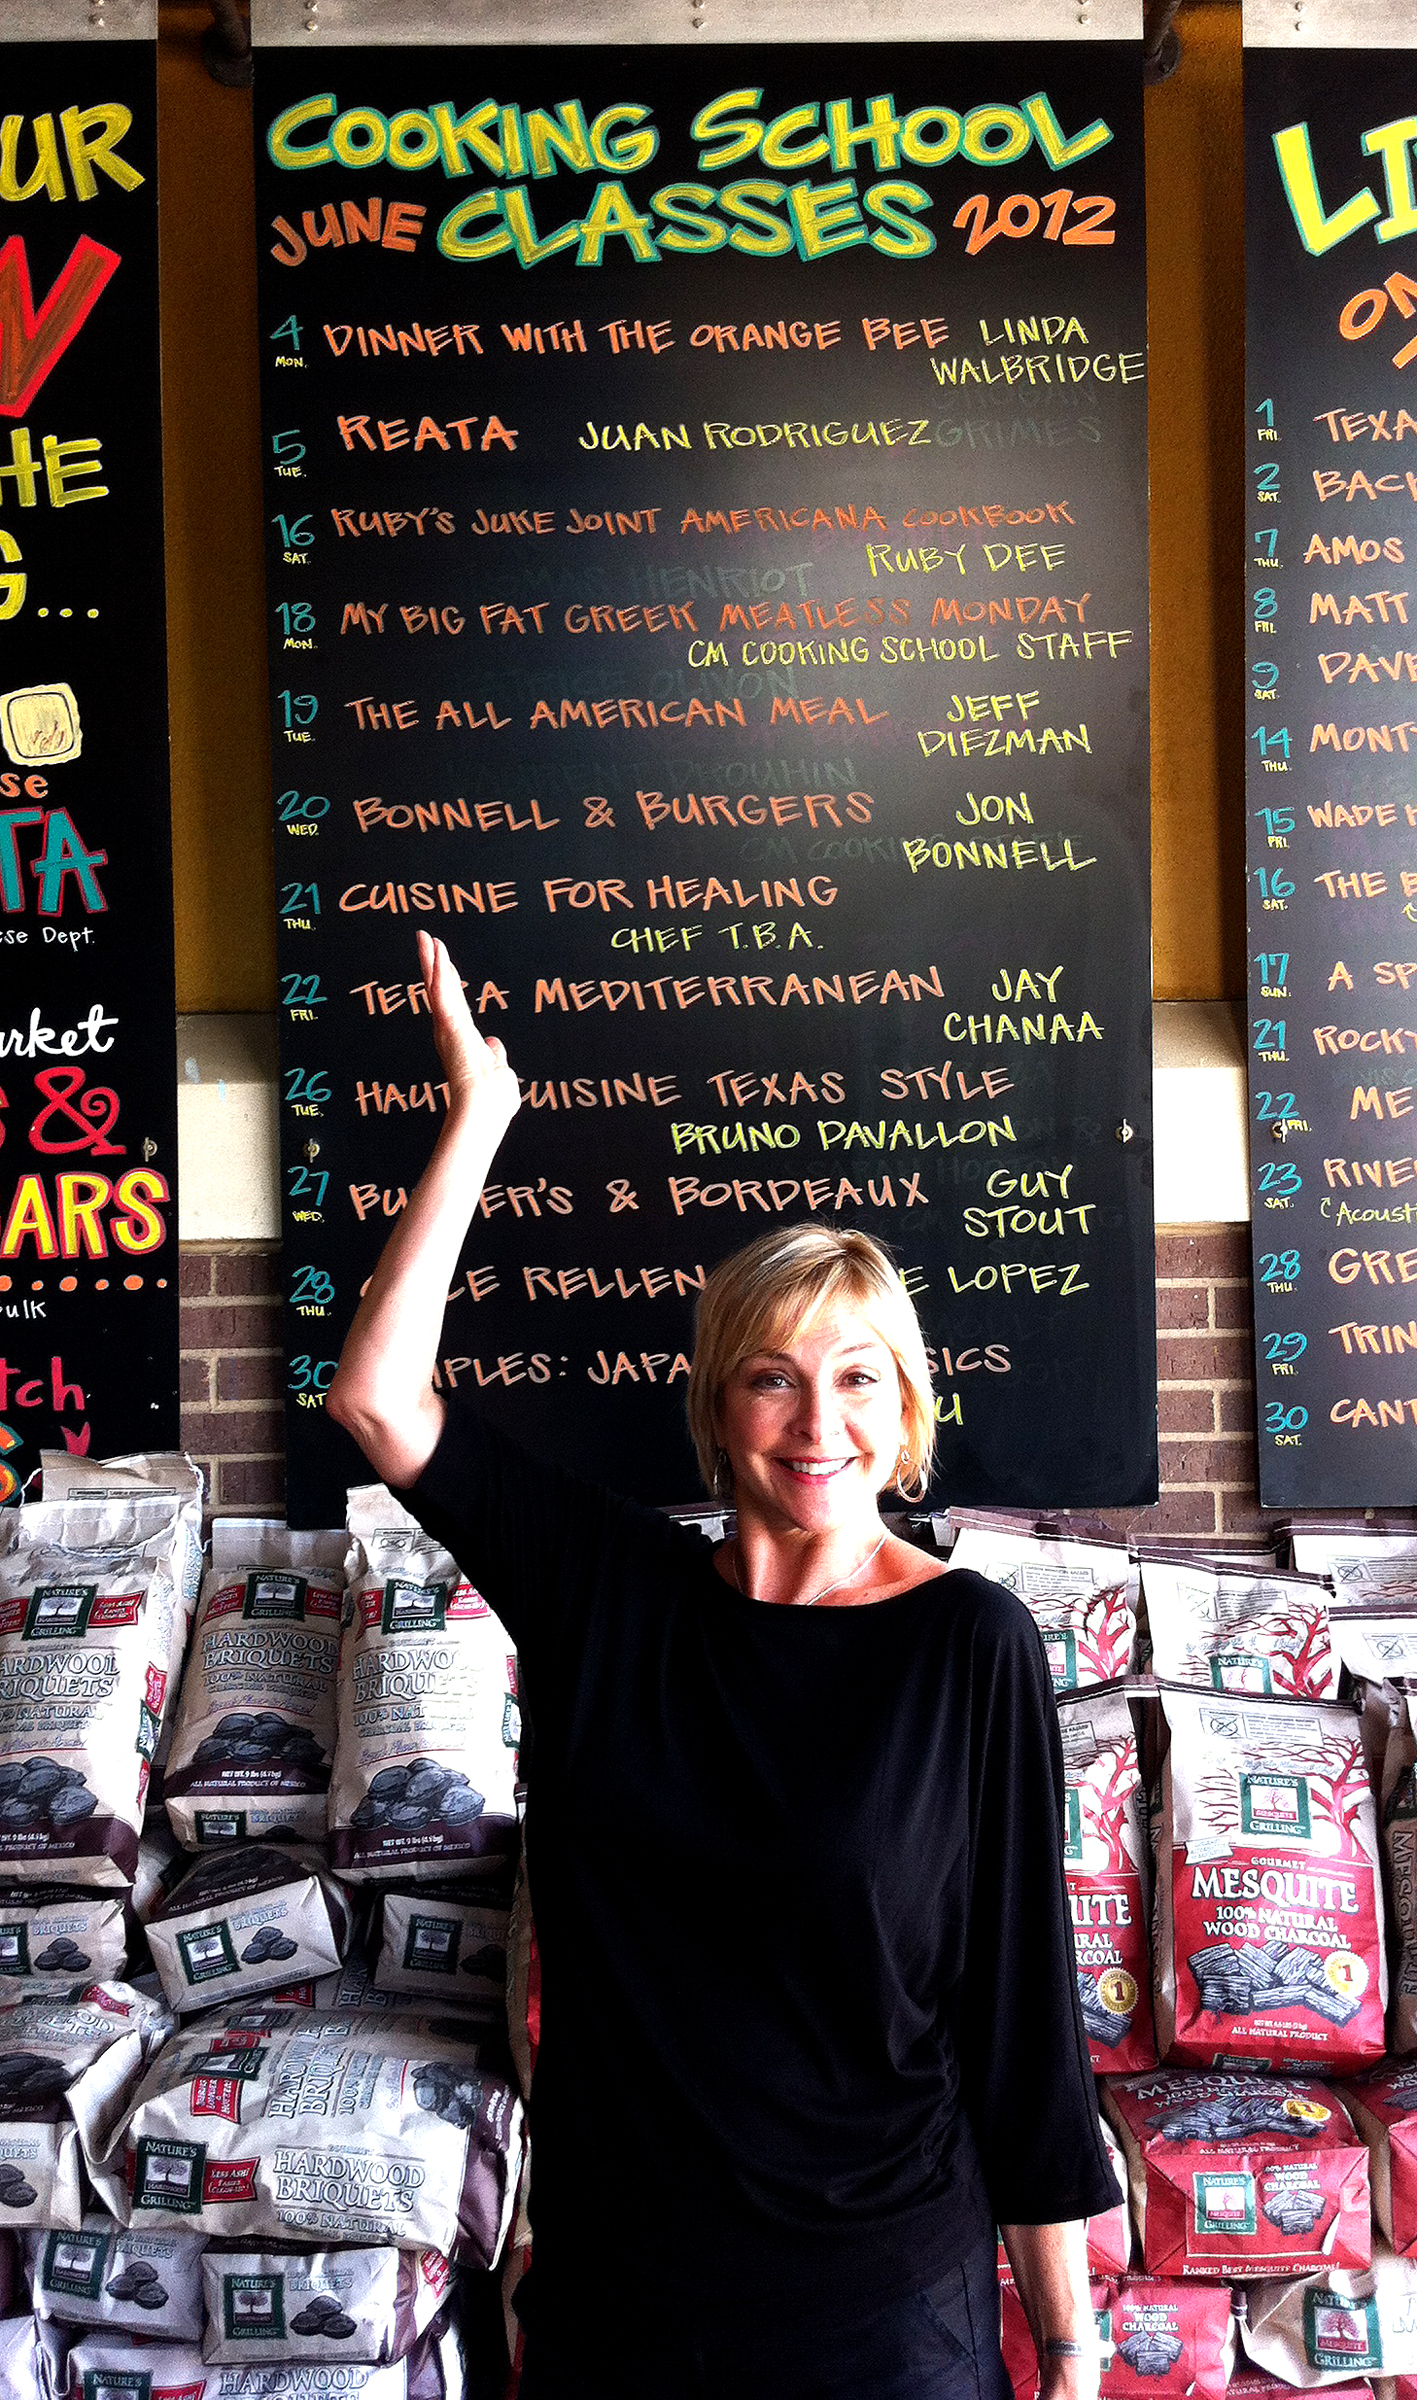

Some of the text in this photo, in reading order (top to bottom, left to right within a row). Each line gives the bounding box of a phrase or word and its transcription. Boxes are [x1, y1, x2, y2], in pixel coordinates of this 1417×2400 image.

[268, 87, 1114, 178] COOKING SCHOOL
[270, 179, 1117, 270] JUNE CLASSES 2012
[270, 315, 1090, 356] 4 DINNER WITH THE ORANGE BEE LINDA
[274, 355, 308, 368] MON.
[929, 351, 1146, 386] WALBRIDGE
[1254, 398, 1275, 428] 1
[271, 414, 932, 465] 5 REATA JUAN RODRIGUEZ
[273, 465, 307, 479] TUE.
[1253, 462, 1282, 491] 2
[271, 499, 1077, 548] 16 RUBY'S JUKE JOINT AMERICANA COOKBOOK
[282, 552, 312, 565] SAT.
[866, 541, 1068, 578] RUBY DEE
[1253, 528, 1406, 566] 7 AMOS
[274, 591, 1093, 636] 18 MY BIG FAT GREEK MEATLESS MONDAY
[1252, 586, 1410, 626] 8 MATT
[282, 636, 319, 650] MON.
[687, 629, 1135, 669] CM COOKING SCHOOL STAFF
[1251, 660, 1280, 690] 9
[276, 689, 1041, 732] 19 THE ALL AMERICAN MEAL JEFF
[282, 729, 316, 743] TUE.
[916, 723, 1094, 760] DIEZMAN
[1250, 725, 1293, 759] 14
[275, 789, 1035, 834] 20 BONNELL & BURGERS JON
[286, 822, 320, 836] WED.
[1253, 799, 1398, 836] 15 WADE
[901, 836, 1098, 874] BONNELL
[278, 874, 840, 916] 21 CUISINE FOR HEALING
[1253, 866, 1388, 900] 16 THE
[42, 925, 97, 953] Dept.
[282, 917, 317, 931] THU.
[610, 920, 826, 955] CHEF T.B.A.
[280, 964, 1066, 1015] 22 MEDITERRANEAN JAY
[1252, 952, 1355, 992] 17 A
[290, 1008, 319, 1022] FRI.
[942, 1010, 1106, 1046] CHANAA
[1252, 1017, 1287, 1051] 21
[283, 1060, 1016, 1108] 26 TEXAS STYLE
[28, 1065, 128, 1157] &
[290, 1102, 324, 1118] TUE.
[1254, 1090, 1300, 1122] 22
[670, 1120, 801, 1156] BRUNO
[286, 1163, 1075, 1216] 27 & BORDEAUX GUY
[1256, 1161, 1303, 1196] 23
[291, 1210, 325, 1223] WED.
[962, 1202, 1097, 1240] STOUT
[289, 1265, 336, 1305] 28
[947, 1262, 1091, 1299] LOPEZ
[1257, 1249, 1302, 1283] 28
[295, 1305, 333, 1318] THU.
[1261, 1331, 1308, 1363] 29
[287, 1355, 338, 1391] 30
[1264, 1400, 1310, 1435] 30
[201, 1631, 340, 1655] HARDWOOD
[203, 1649, 335, 1676] BRIQUETS
[1250, 1820, 1306, 1835] GRILLING
[1191, 1865, 1361, 1915] MESQUITE
[1203, 1920, 1352, 1950] WOOD CHARCOAL
[1215, 1904, 1339, 1933] 100% NATURAL
[144, 2141, 199, 2158] NATURE'S
[273, 2149, 427, 2189] HARDWOOD
[1203, 2175, 1246, 2187] NATURE'S
[1273, 2170, 1309, 2183] WOOD
[140, 2195, 193, 2211] GRILLING
[276, 2175, 415, 2214] BRIQUETS
[277, 2209, 407, 2238] 100% NATURAL
